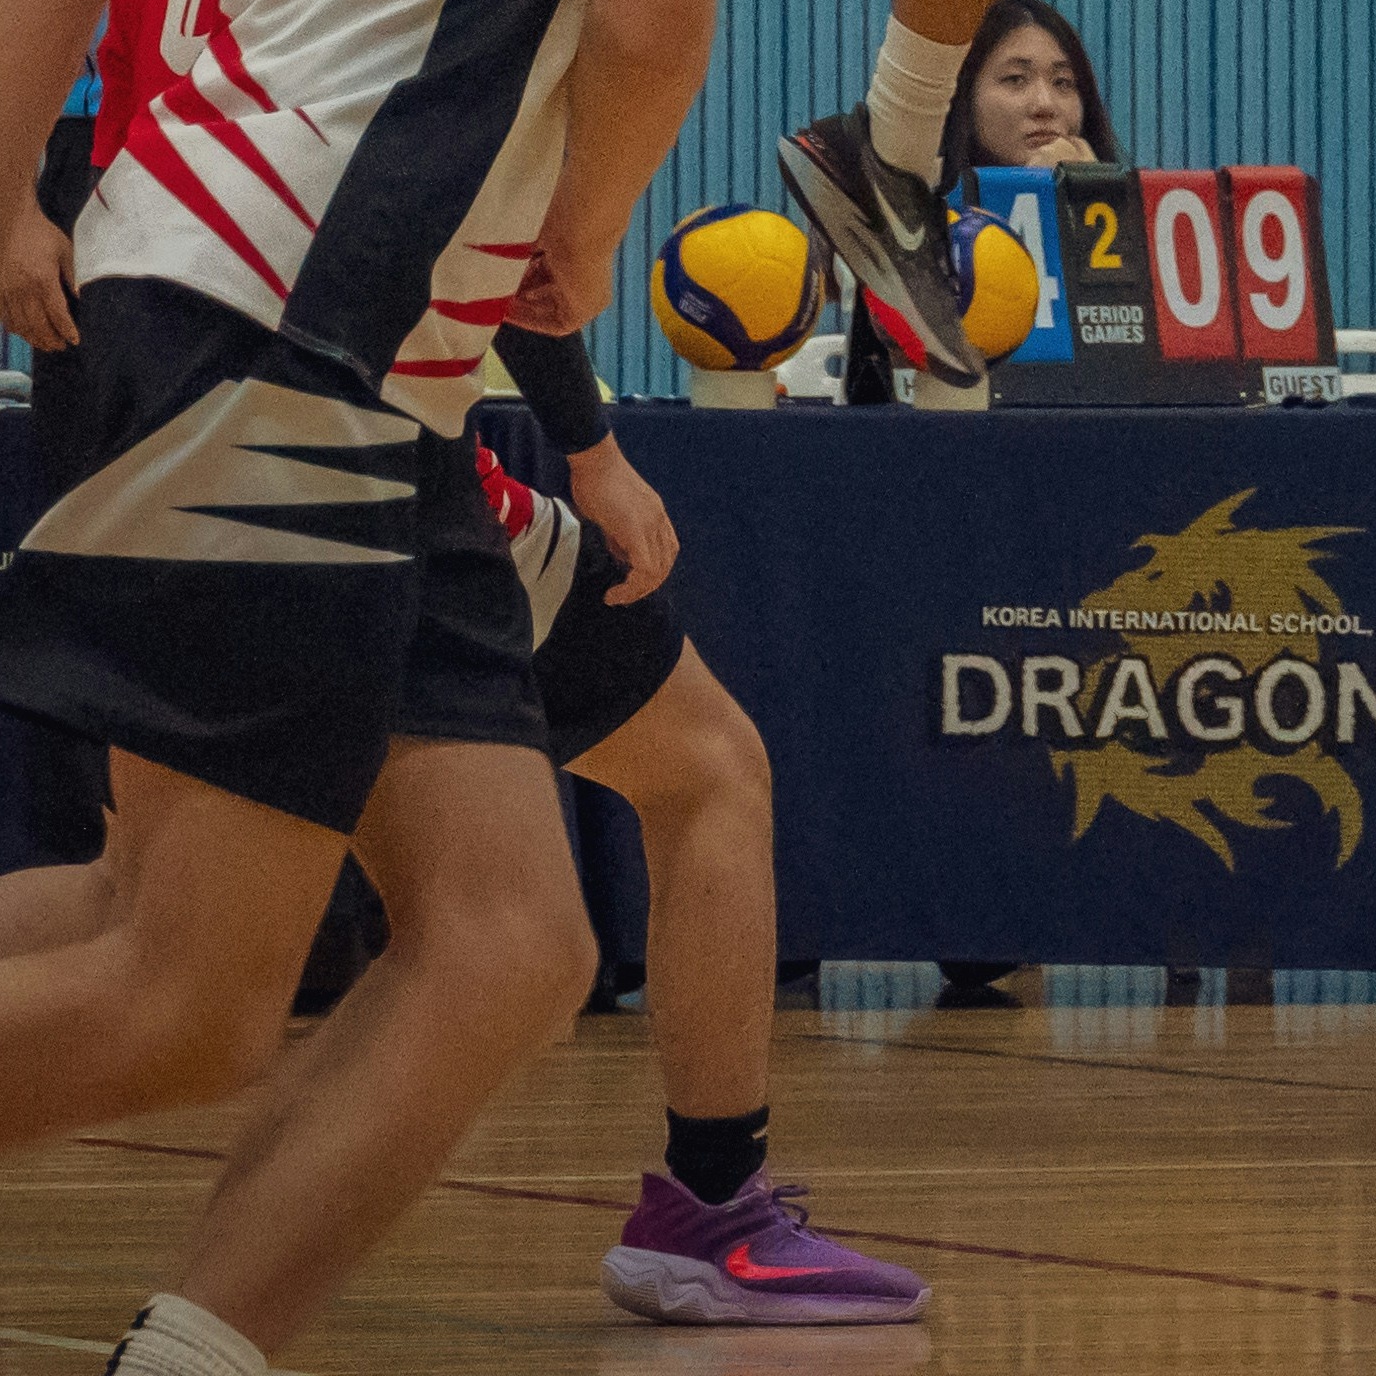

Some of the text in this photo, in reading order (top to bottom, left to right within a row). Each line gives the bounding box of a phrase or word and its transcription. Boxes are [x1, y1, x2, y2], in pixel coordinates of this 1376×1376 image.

[1084, 202, 1122, 269] 2
[1076, 305, 1144, 325] PERIOD
[1081, 324, 1144, 344] GAMES
[1270, 374, 1336, 397] GUEST
[982, 606, 1062, 628] KOREA
[1069, 608, 1263, 633] INTERNATIONAL
